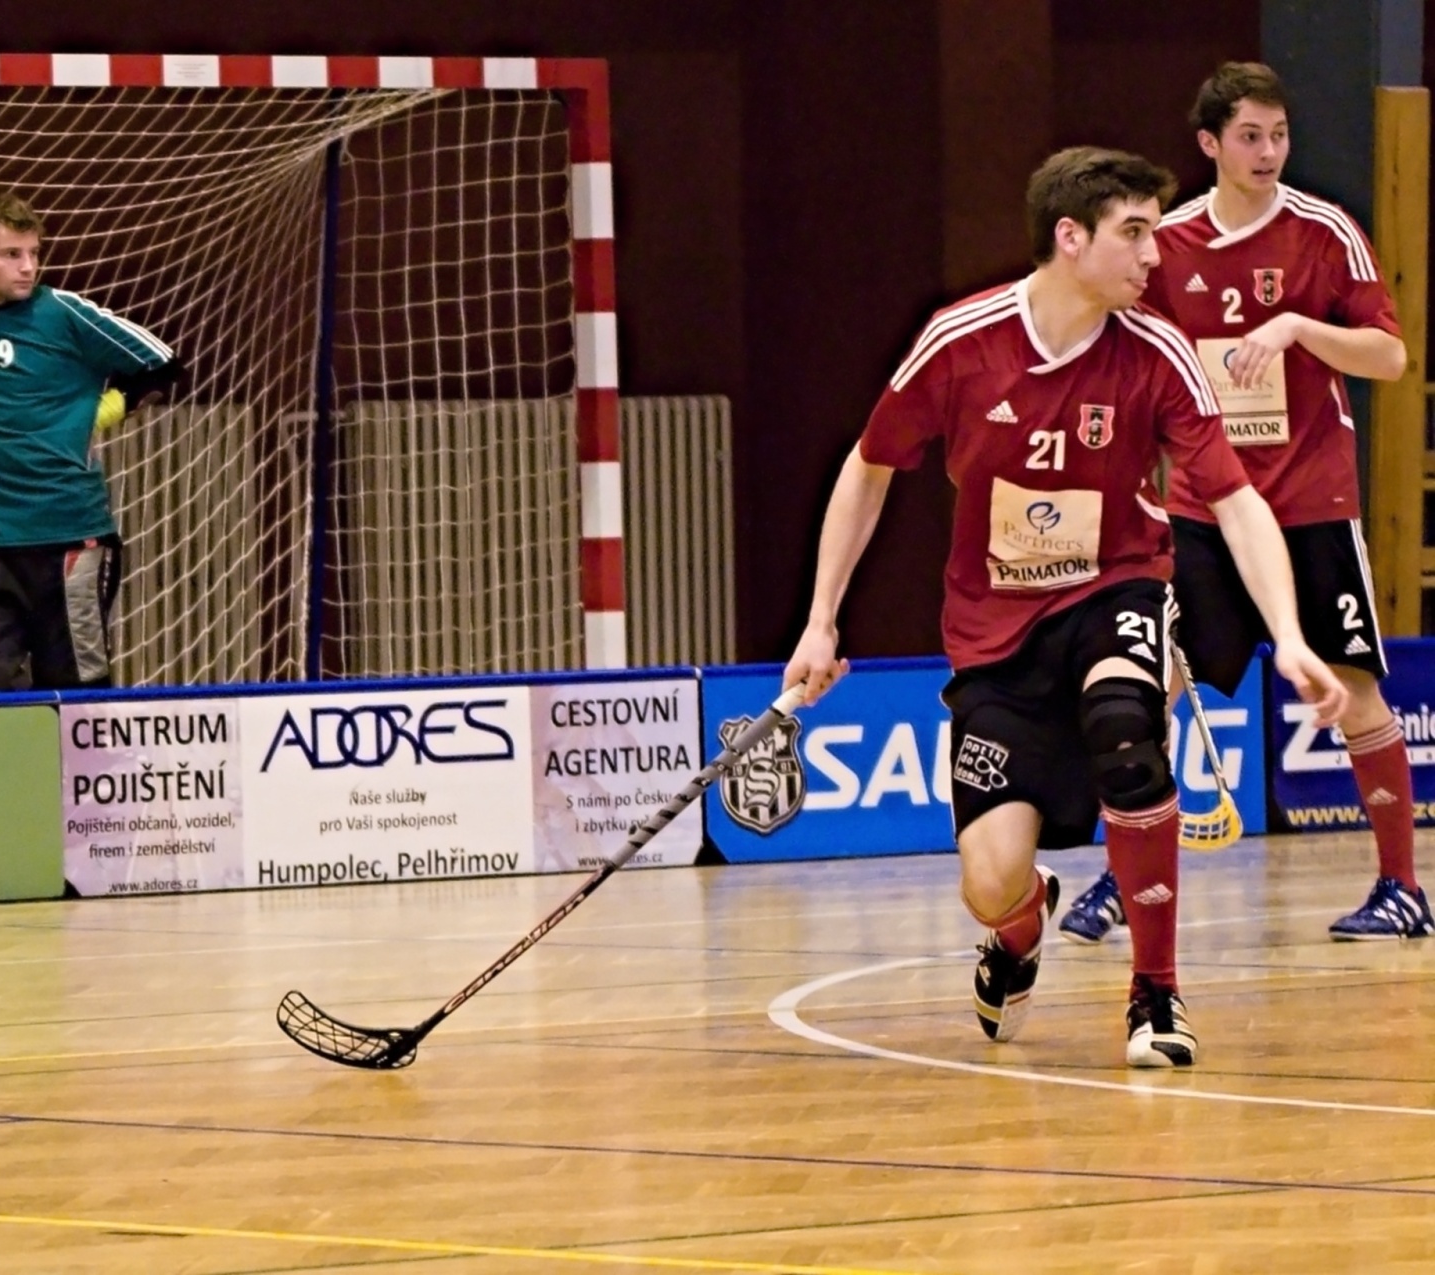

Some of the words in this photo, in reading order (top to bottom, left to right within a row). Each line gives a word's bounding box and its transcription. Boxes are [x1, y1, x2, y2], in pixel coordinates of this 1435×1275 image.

[1221, 287, 1245, 324] 2
[1225, 422, 1281, 437] IMATOR
[1025, 430, 1066, 471] 21
[996, 556, 1090, 582] PRIMATOR
[1116, 611, 1157, 646] 21
[1337, 593, 1364, 631] 2
[550, 688, 679, 728] CESTOVNÍ
[71, 713, 228, 750] CENTRUM
[259, 699, 515, 773] ADORES
[544, 744, 692, 777] AGENTURA
[965, 741, 1002, 763] optik
[73, 760, 227, 806] POJIŠTĚNÍ
[349, 789, 382, 806] Naše
[386, 788, 427, 805] služby
[577, 792, 611, 808] námi
[614, 796, 632, 811] po
[67, 816, 125, 838] Pojištění
[128, 813, 182, 832] občanů,
[185, 812, 236, 829] vozidel,
[319, 818, 343, 836] pro
[346, 814, 373, 831] Vaši
[377, 811, 458, 832] spokojenost
[583, 817, 627, 835] zbytku
[88, 843, 126, 859] firem
[136, 838, 216, 857] zemědělství
[258, 854, 389, 886] Humpolec,
[397, 847, 519, 878] Pelhřimov
